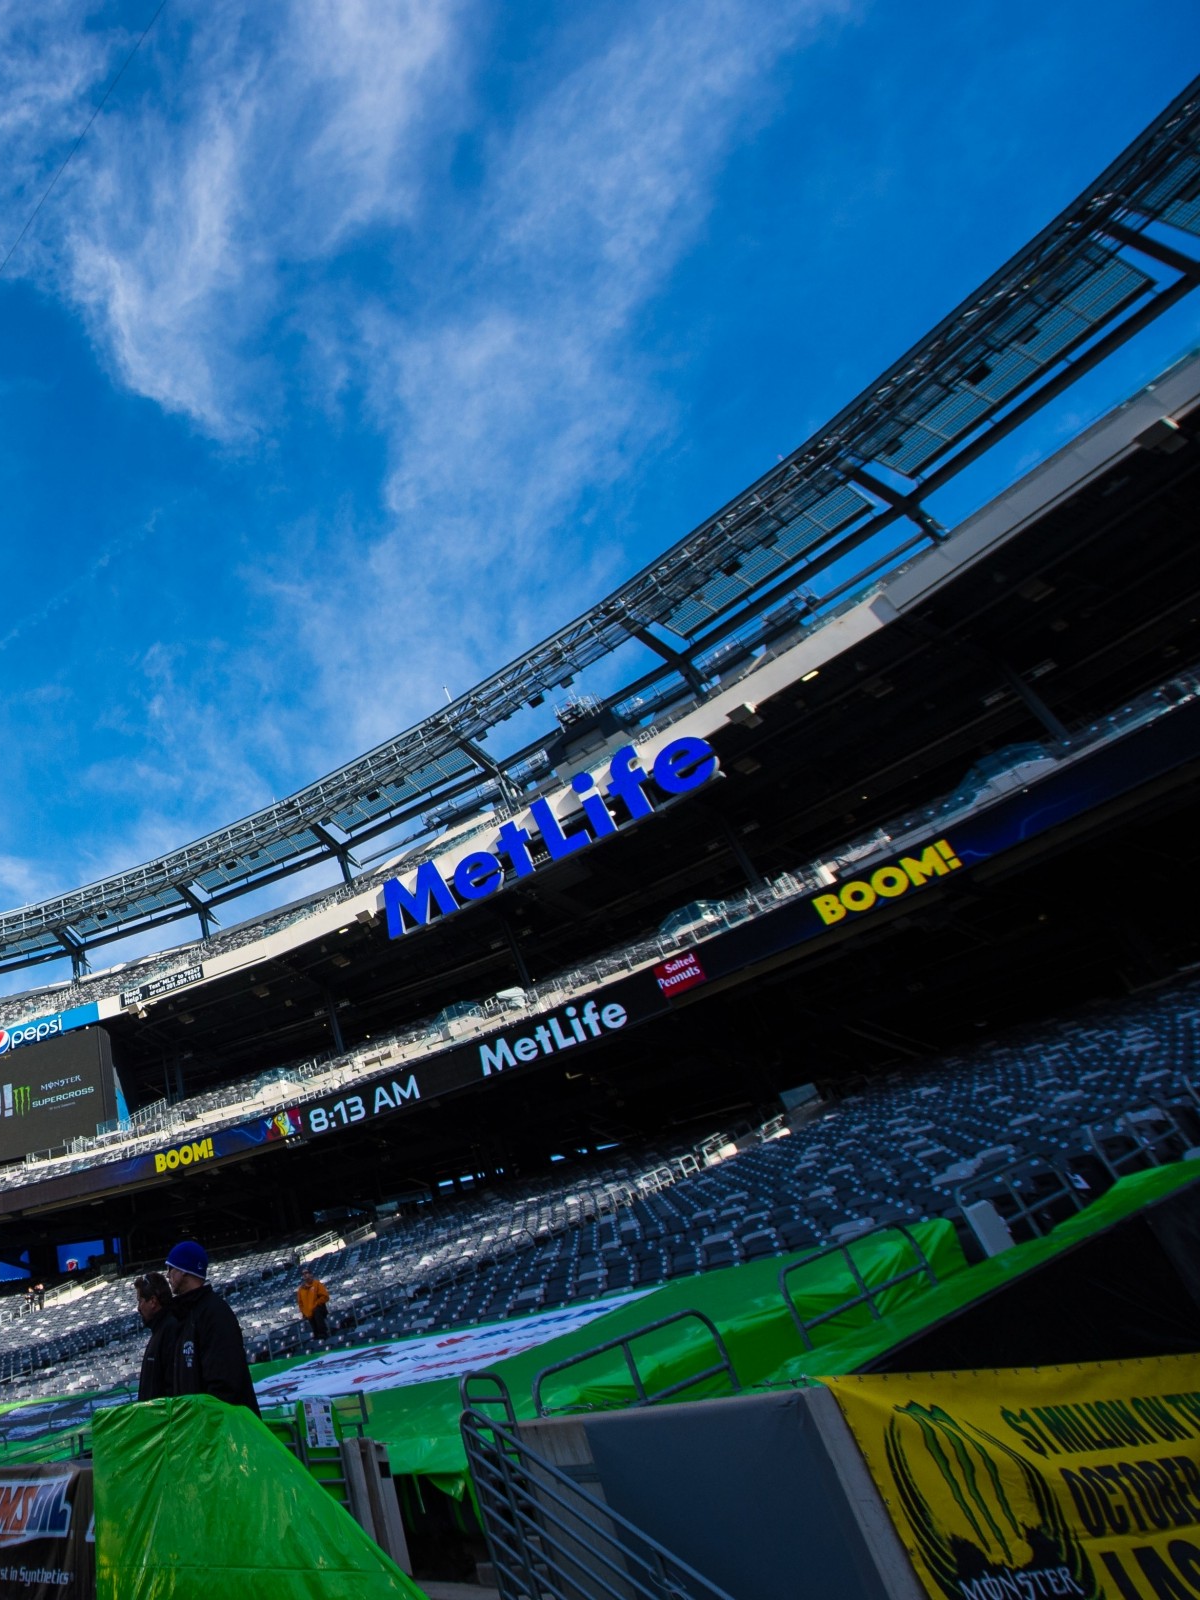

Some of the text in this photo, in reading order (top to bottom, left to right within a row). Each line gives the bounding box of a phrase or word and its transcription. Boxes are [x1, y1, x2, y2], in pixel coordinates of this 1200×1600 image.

[383, 736, 719, 940] MetLife
[812, 839, 963, 925] BOOM!
[658, 966, 701, 990] Peanuts
[664, 953, 695, 974] Salted
[11, 1015, 63, 1048] pepsi
[479, 1000, 628, 1077] MetLife
[31, 1086, 95, 1108] SUPERCROSS
[40, 1074, 82, 1091] MONSTER
[308, 1075, 421, 1134] 8:13 AM
[155, 1138, 215, 1173] BOOM!
[1031, 1400, 1157, 1453] MILLION
[1131, 1396, 1194, 1442] ON
[10, 1565, 18, 1581] in
[20, 1564, 70, 1587] Synthetics
